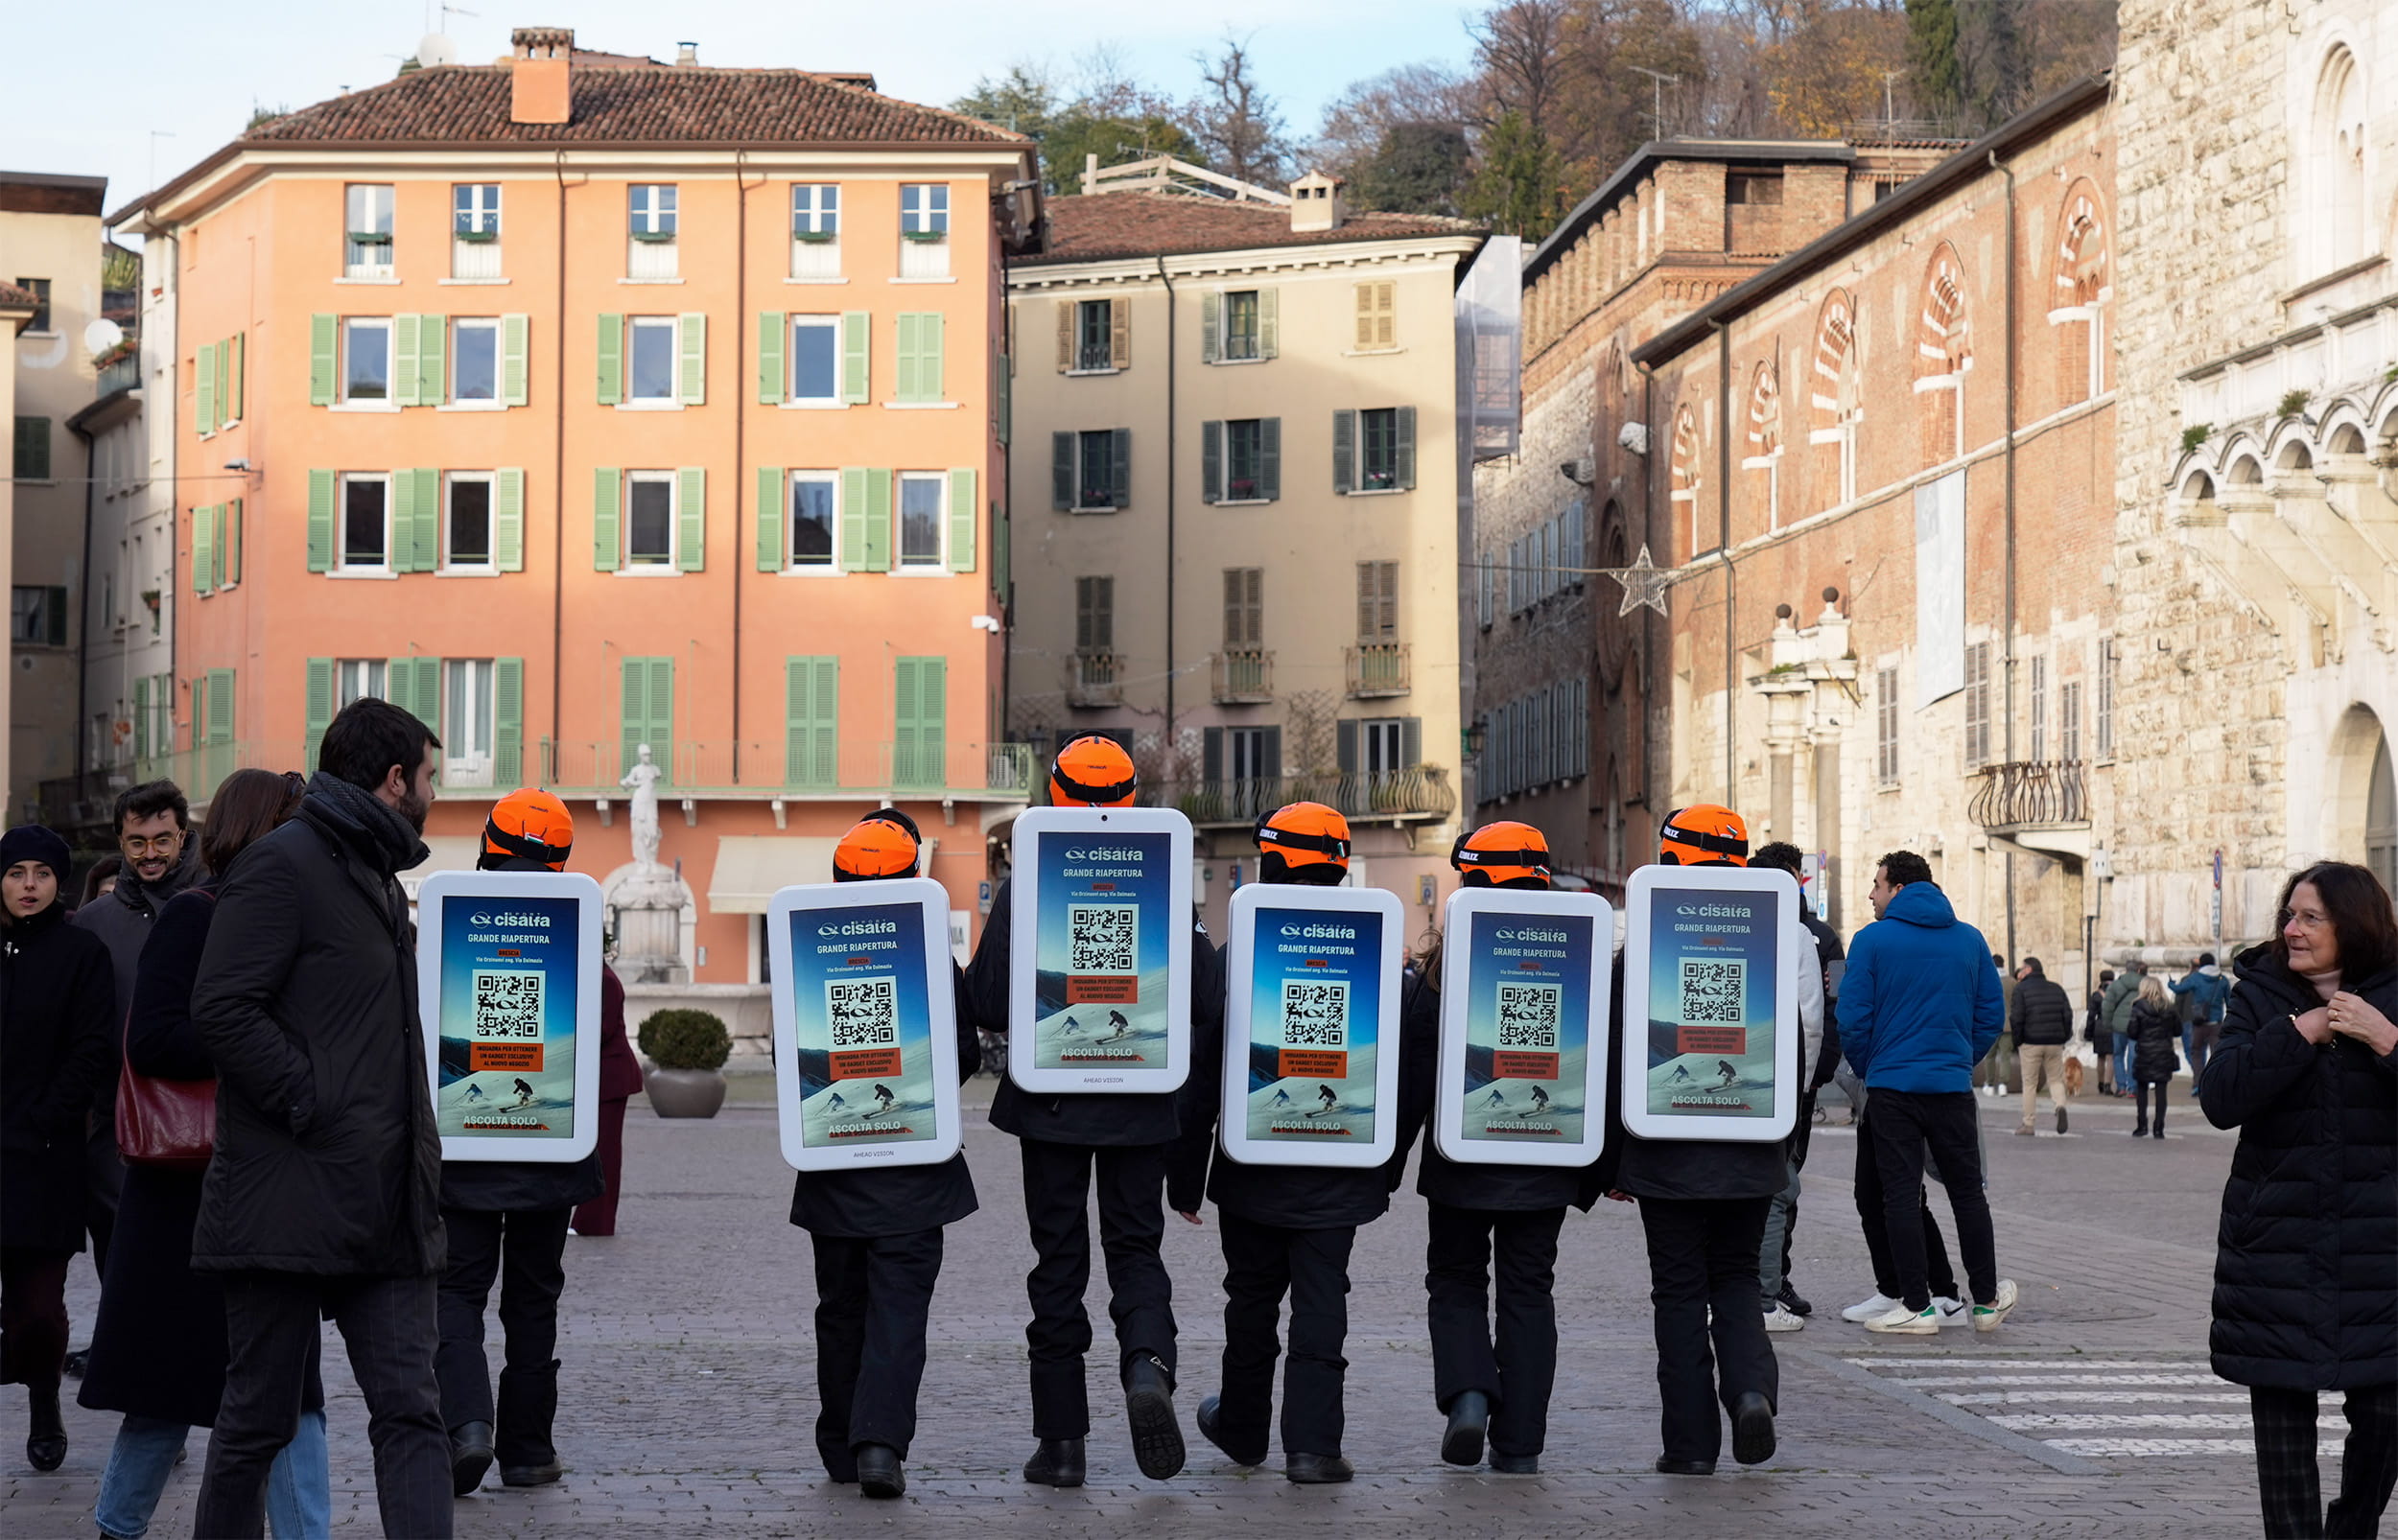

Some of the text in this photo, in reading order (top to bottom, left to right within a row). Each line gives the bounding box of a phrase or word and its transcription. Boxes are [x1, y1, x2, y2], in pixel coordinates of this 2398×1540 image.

[1089, 847, 1143, 861] cisalfa
[1063, 869, 1143, 877] GRANDE RIAPERTURA
[1699, 904, 1751, 918] cisalfa
[494, 912, 551, 928] cisalfa
[842, 922, 896, 935] cisalfa
[1303, 924, 1355, 939] cisalfa
[1674, 924, 1750, 933] GRANDE RIAPERTURA
[468, 934, 550, 944] GRANDE RIAPERTURA
[1517, 928, 1567, 943] cisalfa
[817, 941, 897, 954] GRANDE RIAPERTURA
[1278, 944, 1355, 955] GRANDE RIAPERTURA
[1493, 948, 1566, 958] GRANDE RIAPERTURA
[463, 1116, 537, 1125] ASCOLTA SOLO
[1271, 1120, 1340, 1130] ASCOLTA SOLO
[1486, 1121, 1526, 1129] ASCOLTA
[829, 1121, 900, 1133] ASCOLTA SOLO
